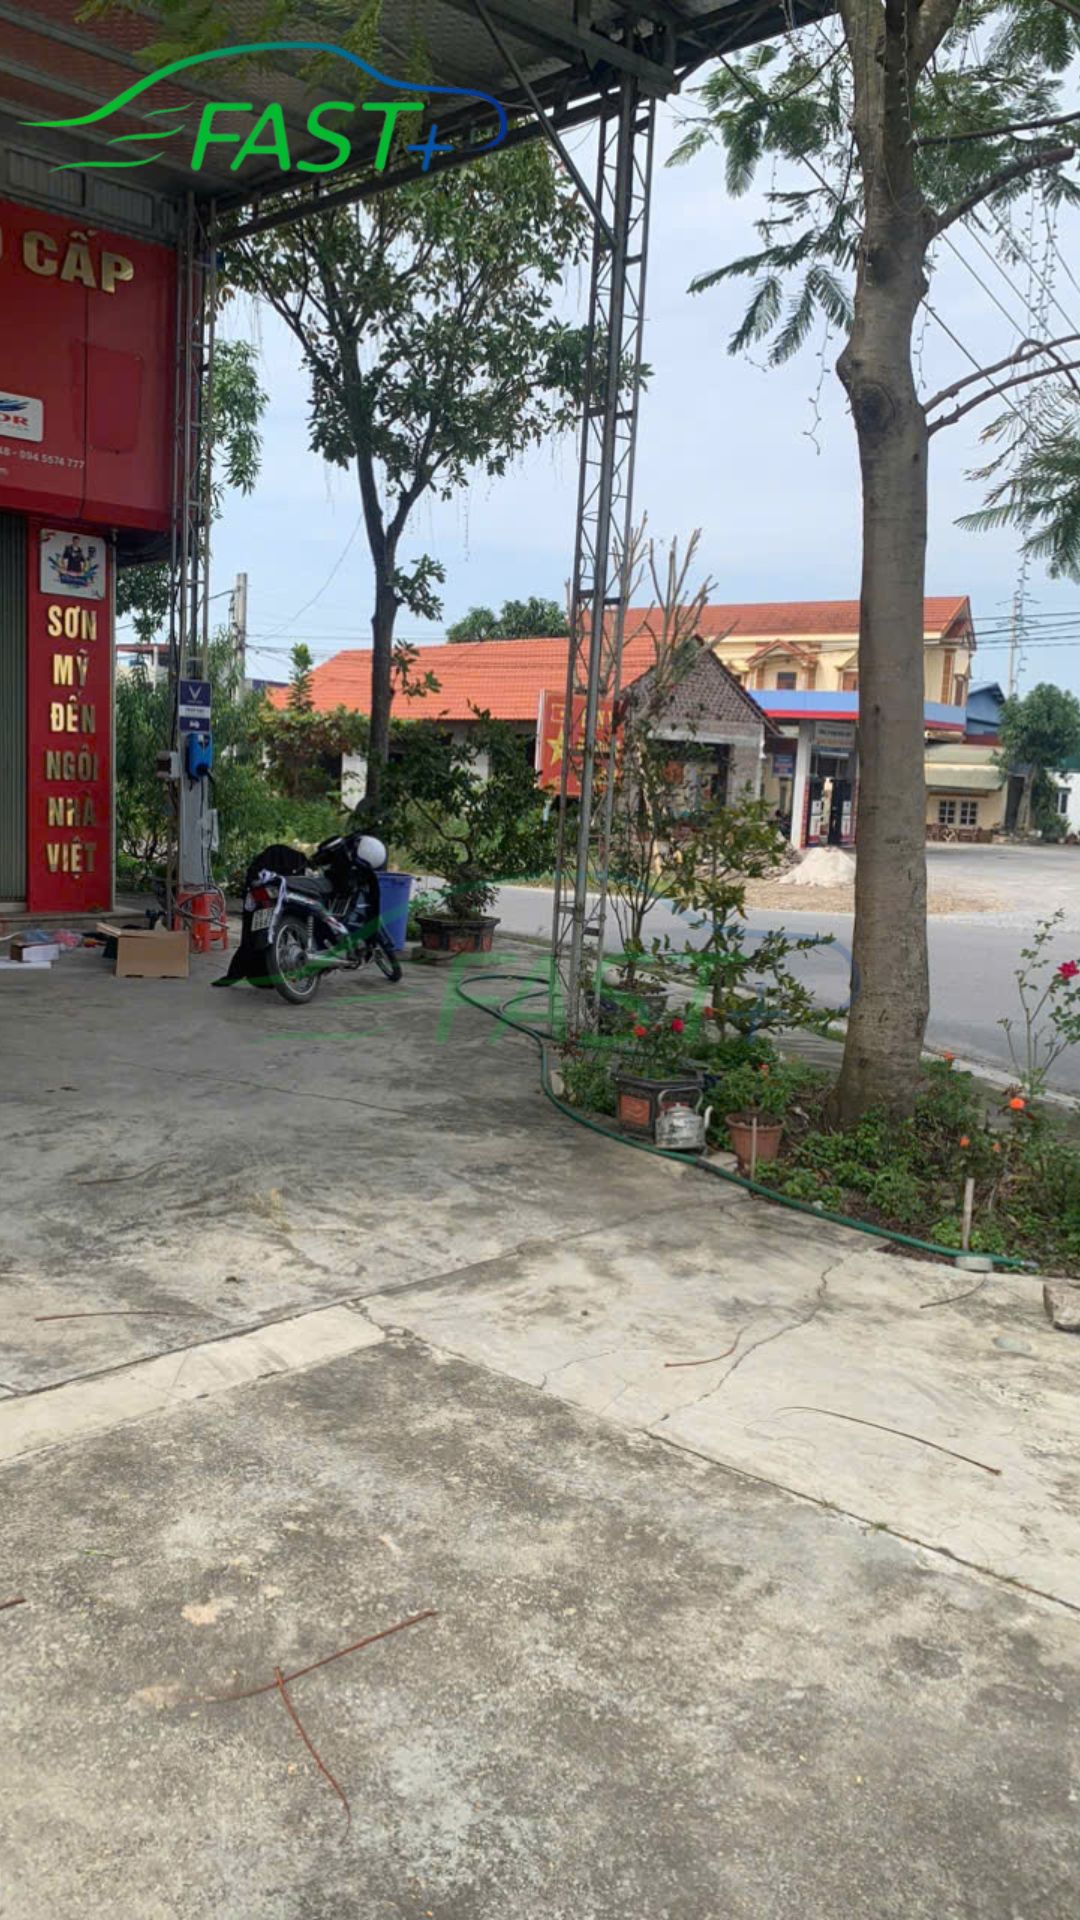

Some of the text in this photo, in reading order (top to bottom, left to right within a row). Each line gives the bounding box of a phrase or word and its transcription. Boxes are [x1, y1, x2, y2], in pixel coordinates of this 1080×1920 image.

[22, 229, 134, 294] CẤP
[66, 457, 85, 469] 777
[48, 604, 97, 641] SƠN
[53, 648, 89, 687] MỸ
[50, 689, 96, 734] ĐẾN
[46, 743, 98, 782] NGÔI
[48, 789, 97, 828] NHÀ
[46, 835, 97, 879] VIỆT
